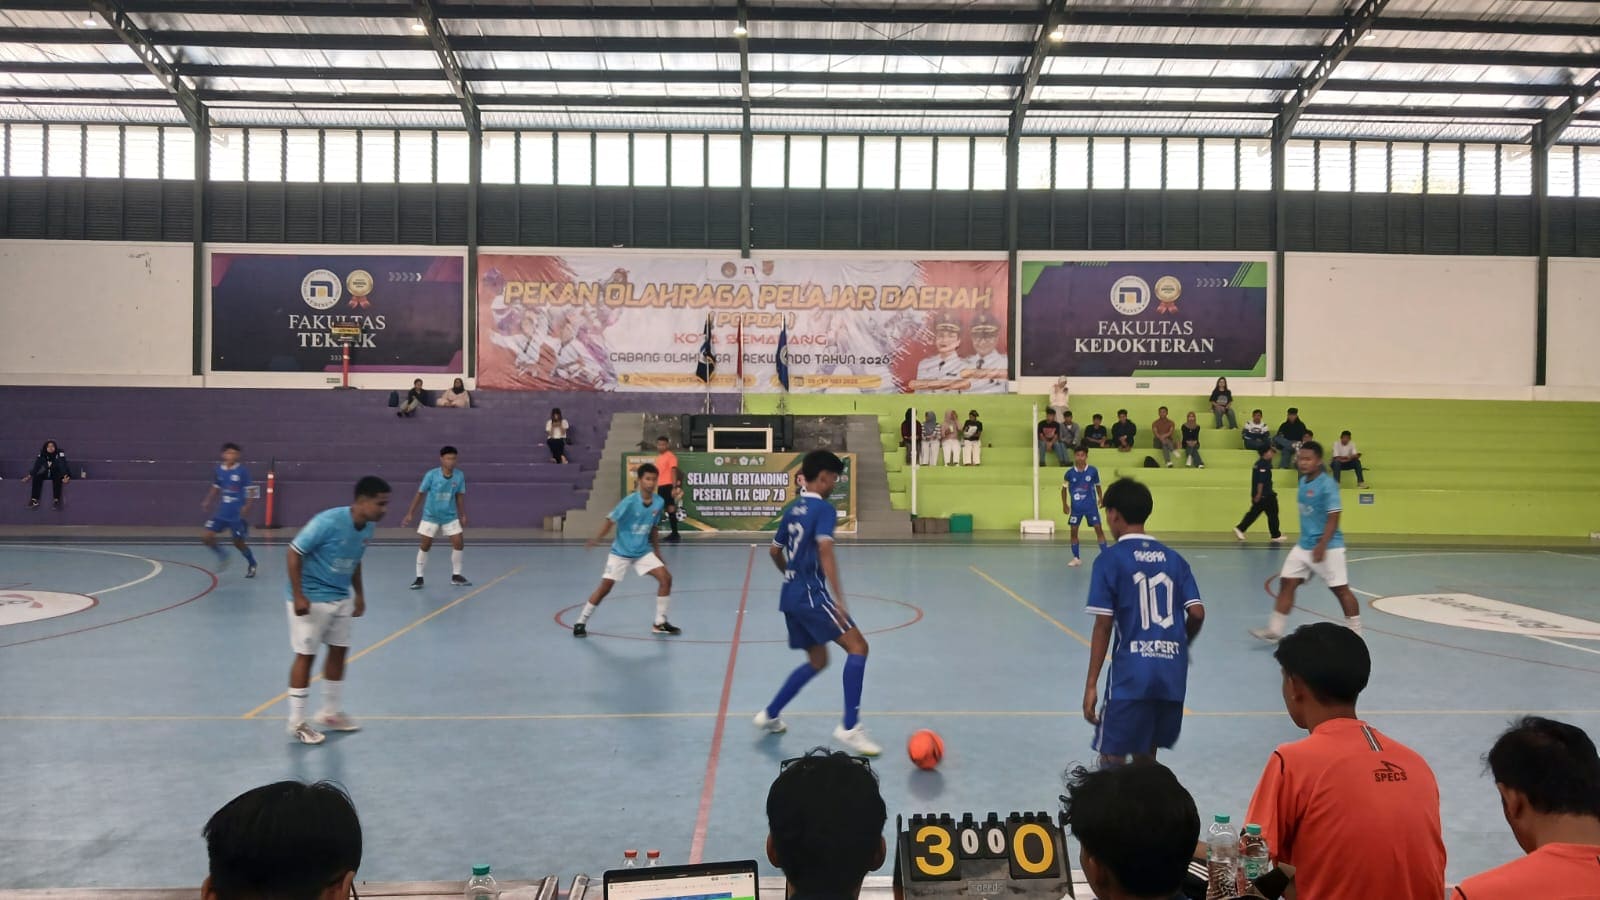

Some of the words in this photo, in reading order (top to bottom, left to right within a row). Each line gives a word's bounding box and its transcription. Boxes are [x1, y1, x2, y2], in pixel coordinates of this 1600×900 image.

[504, 281, 600, 305] PEKAN
[603, 282, 753, 308] OLAHRAGA
[758, 284, 876, 310] PELAJAR
[880, 285, 992, 310] DAERAH
[1097, 320, 1193, 336] FAKULTAS
[726, 334, 827, 345] SEMAANG
[1074, 338, 1215, 353] KEDOKTERAN
[609, 352, 660, 363] CABANG
[663, 352, 731, 363] OLAHGA
[815, 354, 856, 365] TAHUN
[859, 353, 891, 365] 2026
[687, 472, 730, 486] SELAMAT
[731, 472, 789, 486] BERTANDING
[692, 488, 734, 502] PESERTA
[735, 488, 751, 502] FIX
[752, 488, 771, 502] CUP
[1132, 570, 1174, 631] 10
[1374, 771, 1408, 783] SPECS
[915, 825, 954, 876] 3
[1013, 823, 1054, 873] 0
